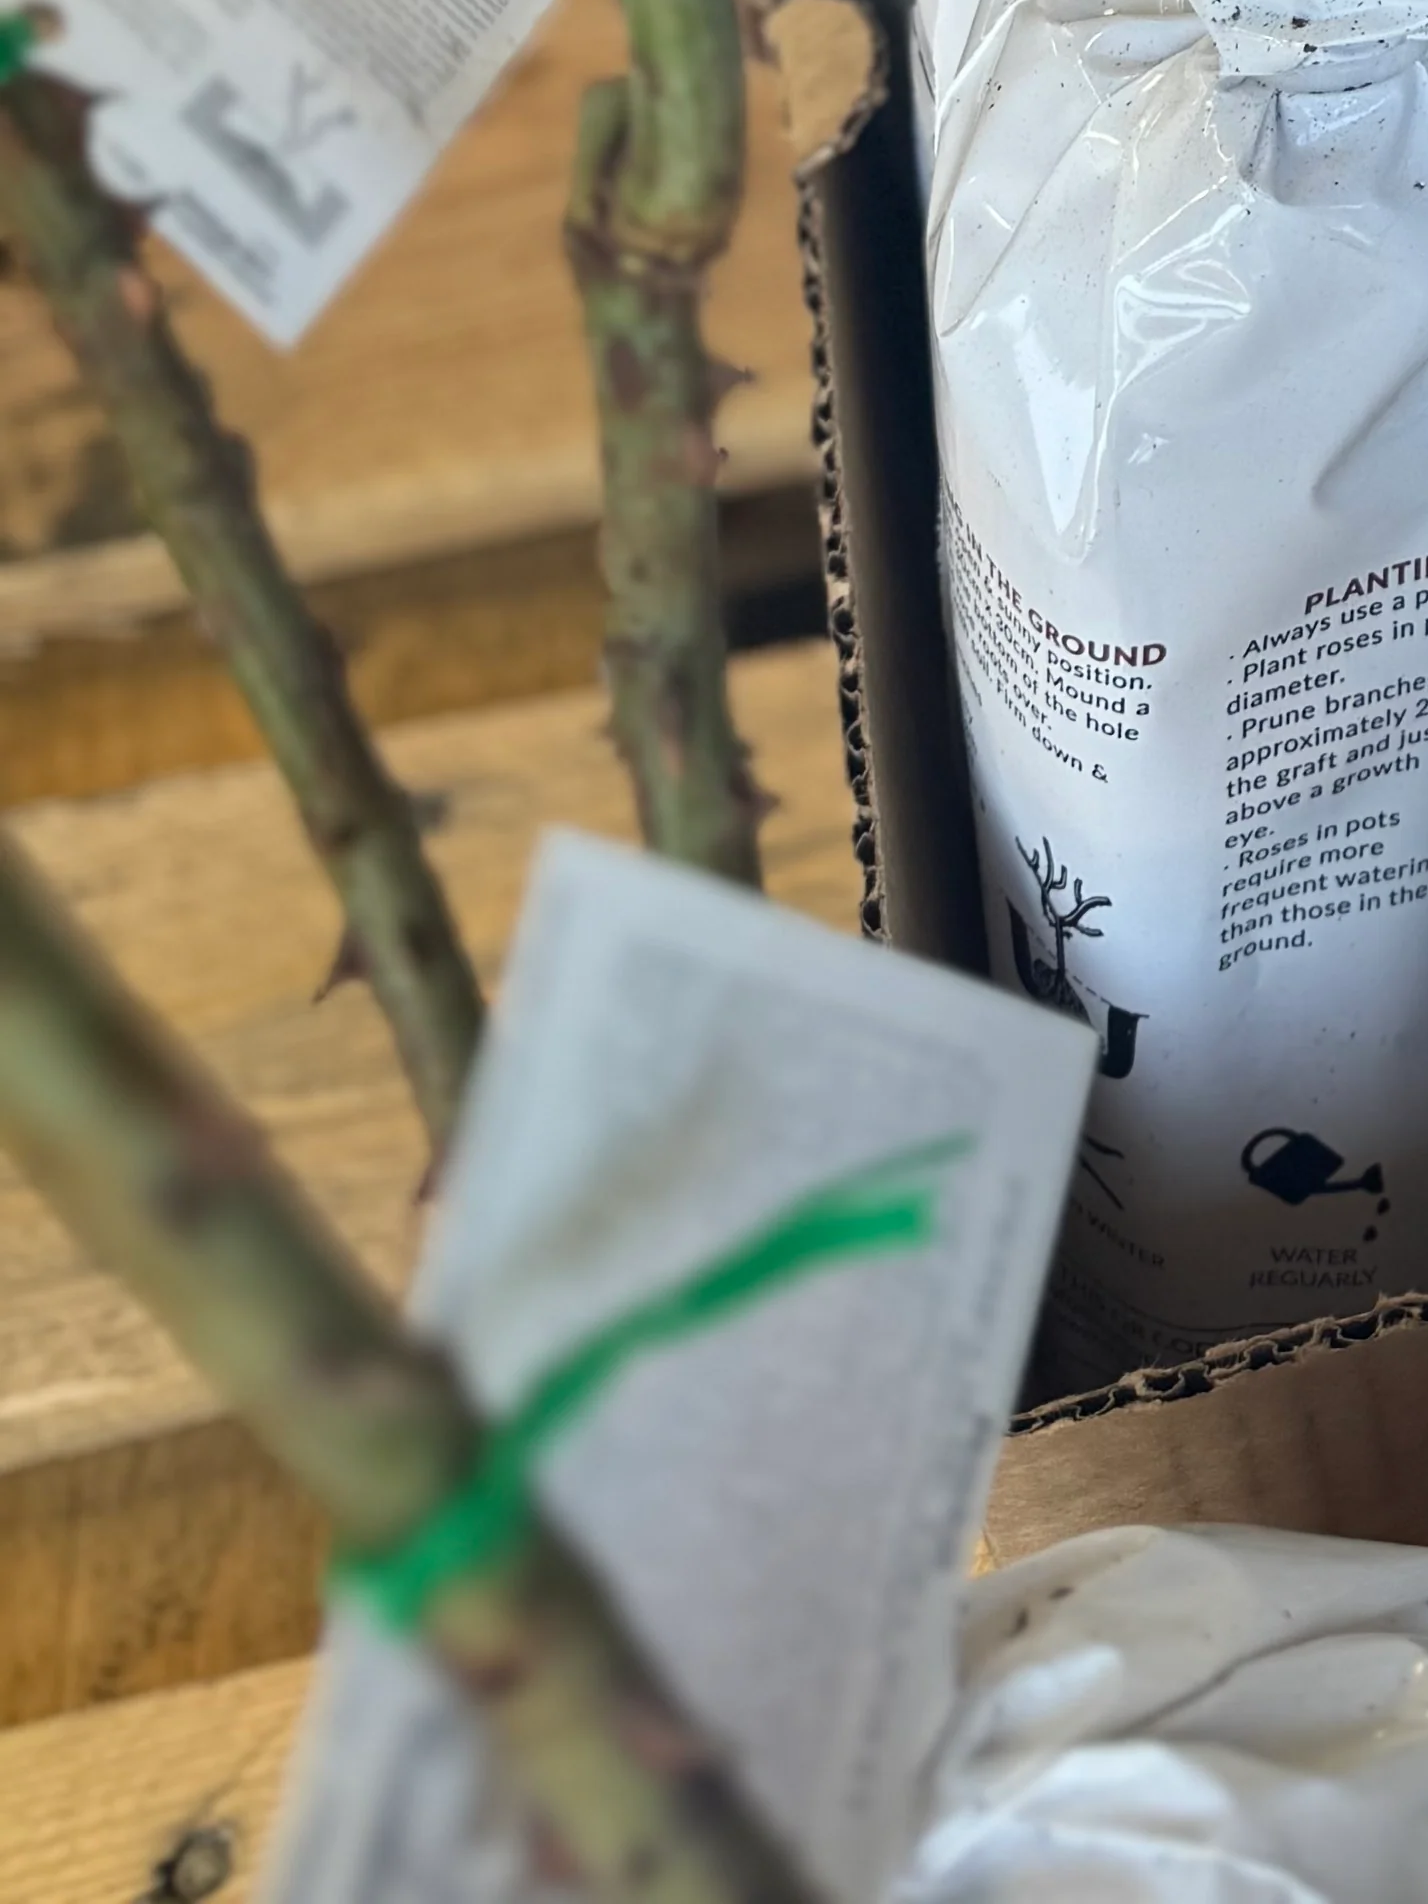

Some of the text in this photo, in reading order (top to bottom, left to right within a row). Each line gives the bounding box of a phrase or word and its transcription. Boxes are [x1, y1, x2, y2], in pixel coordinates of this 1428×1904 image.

[987, 554, 1167, 667] THE GROUND
[1241, 595, 1406, 660] Always use a
[997, 596, 1153, 691] sunny position.
[1241, 652, 1309, 685] Plant
[1314, 632, 1386, 666] roses
[1391, 620, 1415, 641] in
[1045, 668, 1150, 716] Mound a
[1045, 691, 1140, 741] the hole
[1225, 667, 1347, 718] diameter.
[1239, 701, 1318, 741] Prune
[1031, 726, 1083, 772] down
[1091, 764, 1108, 783] &
[1224, 700, 1407, 774] approximately
[1224, 753, 1422, 828] above a growth
[1225, 770, 1269, 800] the
[1274, 748, 1338, 786] graft
[1344, 741, 1392, 767] and
[1223, 819, 1277, 853] eye.
[1237, 808, 1402, 873] Roses in pots
[1218, 873, 1330, 922] frequent
[1219, 838, 1386, 898] require more
[1218, 878, 1428, 945] than those in the
[1217, 928, 1314, 972] ground.
[1271, 1245, 1358, 1265] WATER
